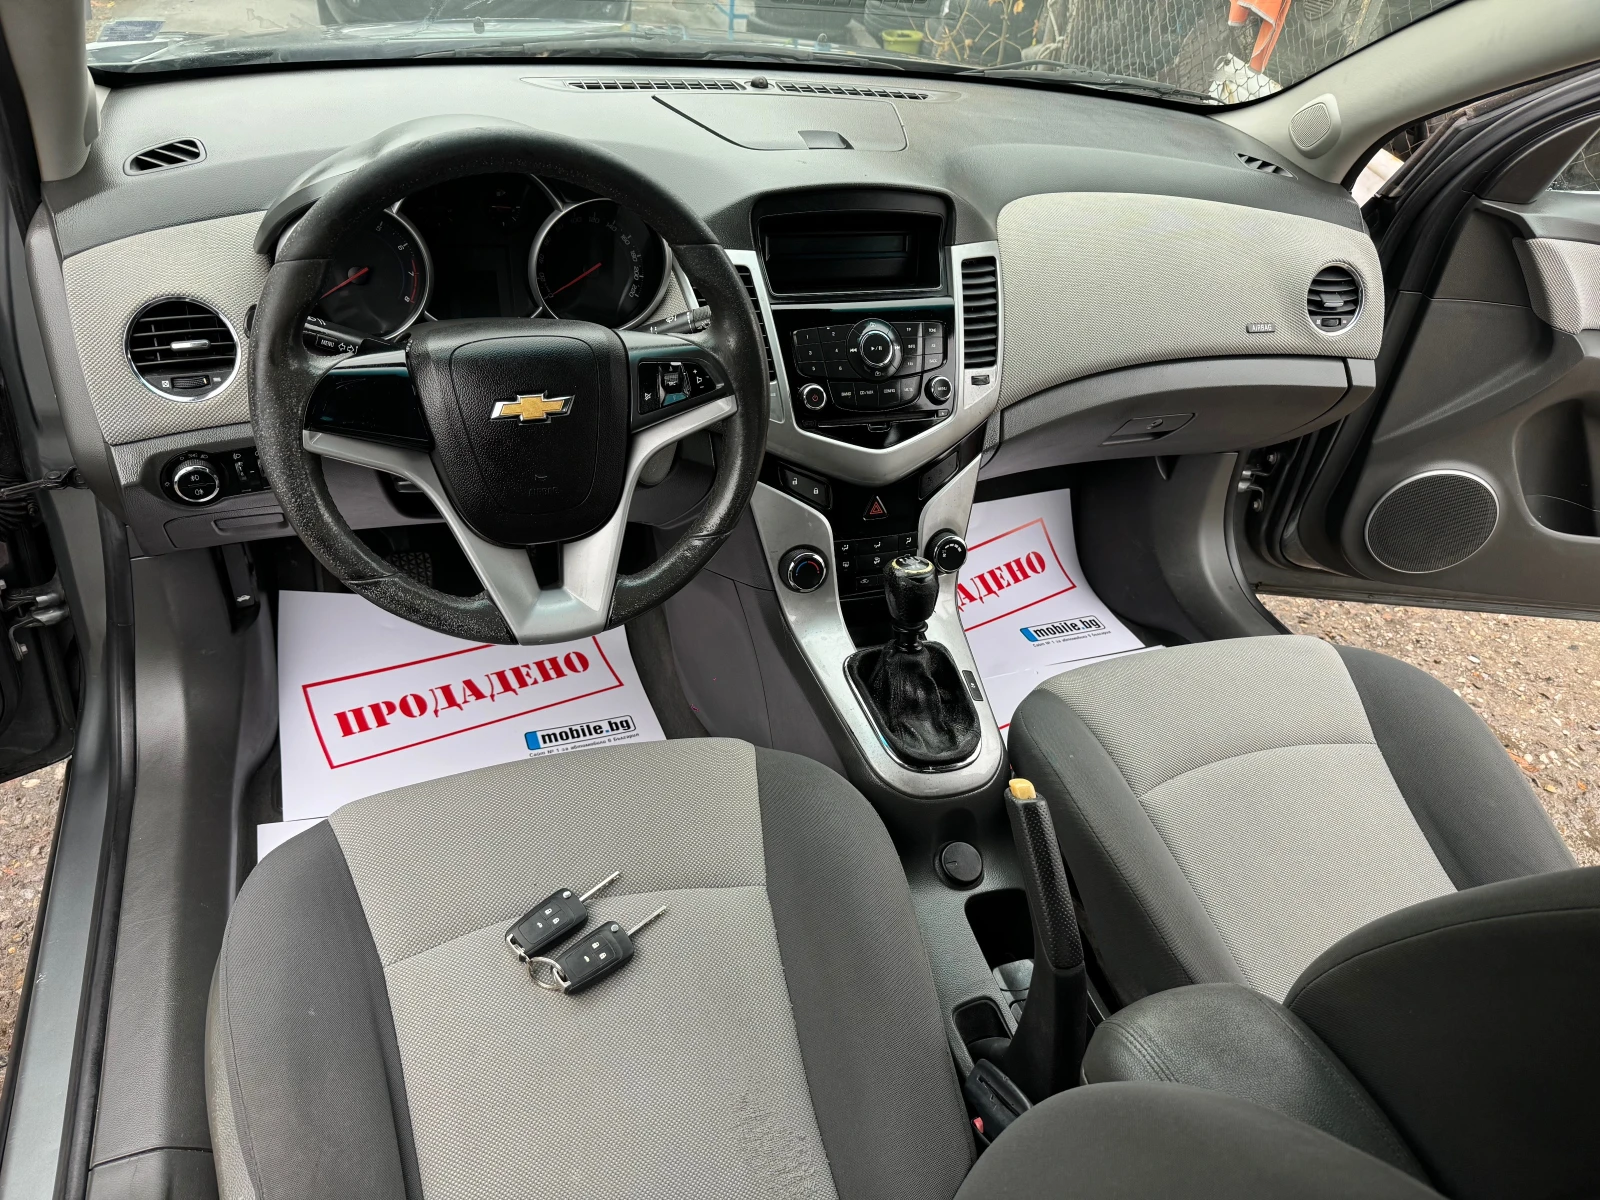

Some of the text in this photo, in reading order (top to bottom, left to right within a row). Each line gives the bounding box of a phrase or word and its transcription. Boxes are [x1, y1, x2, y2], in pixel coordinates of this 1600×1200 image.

[628, 284, 638, 297] 220
[320, 339, 335, 348] MENU
[957, 551, 1046, 612] АДЕНО
[1033, 617, 1102, 638] mobile.bg
[333, 651, 590, 738] ПРОДАДЕНО
[540, 719, 632, 744] mobile.bg
